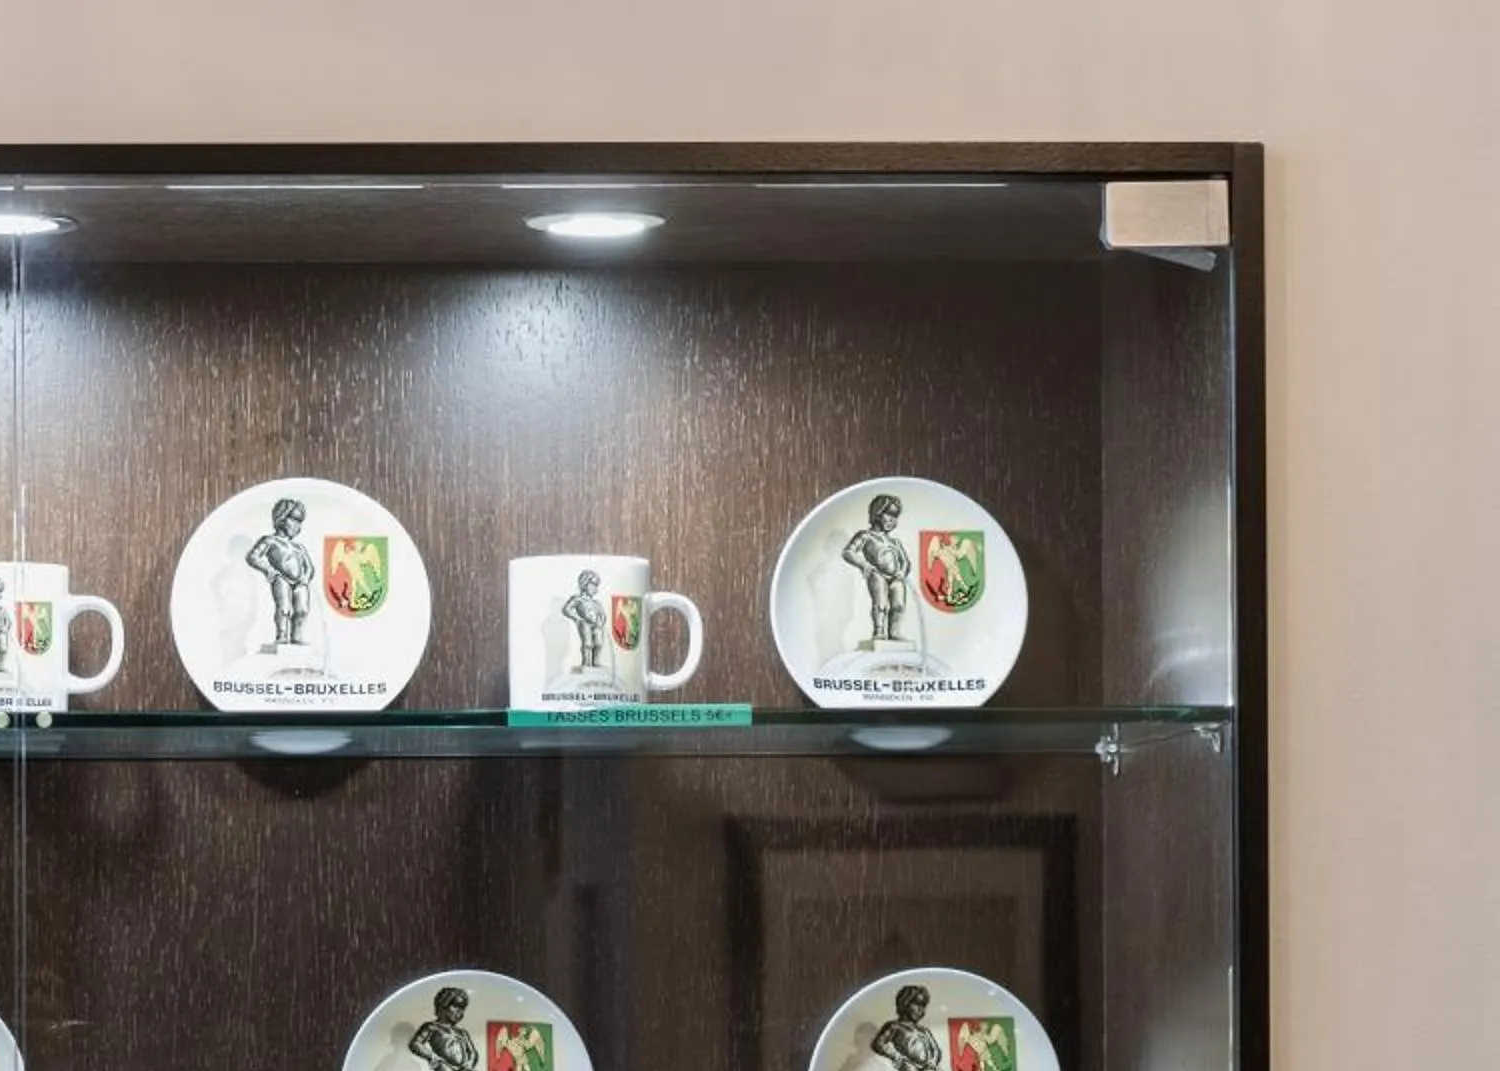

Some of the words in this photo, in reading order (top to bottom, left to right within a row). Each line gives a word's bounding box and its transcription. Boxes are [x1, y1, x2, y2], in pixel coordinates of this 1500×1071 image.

[213, 680, 387, 696] BRUSSEL-BRUXELLES
[813, 677, 985, 692] BRUSSEL-BRUXELLES
[615, 708, 701, 723] BRUSSELS
